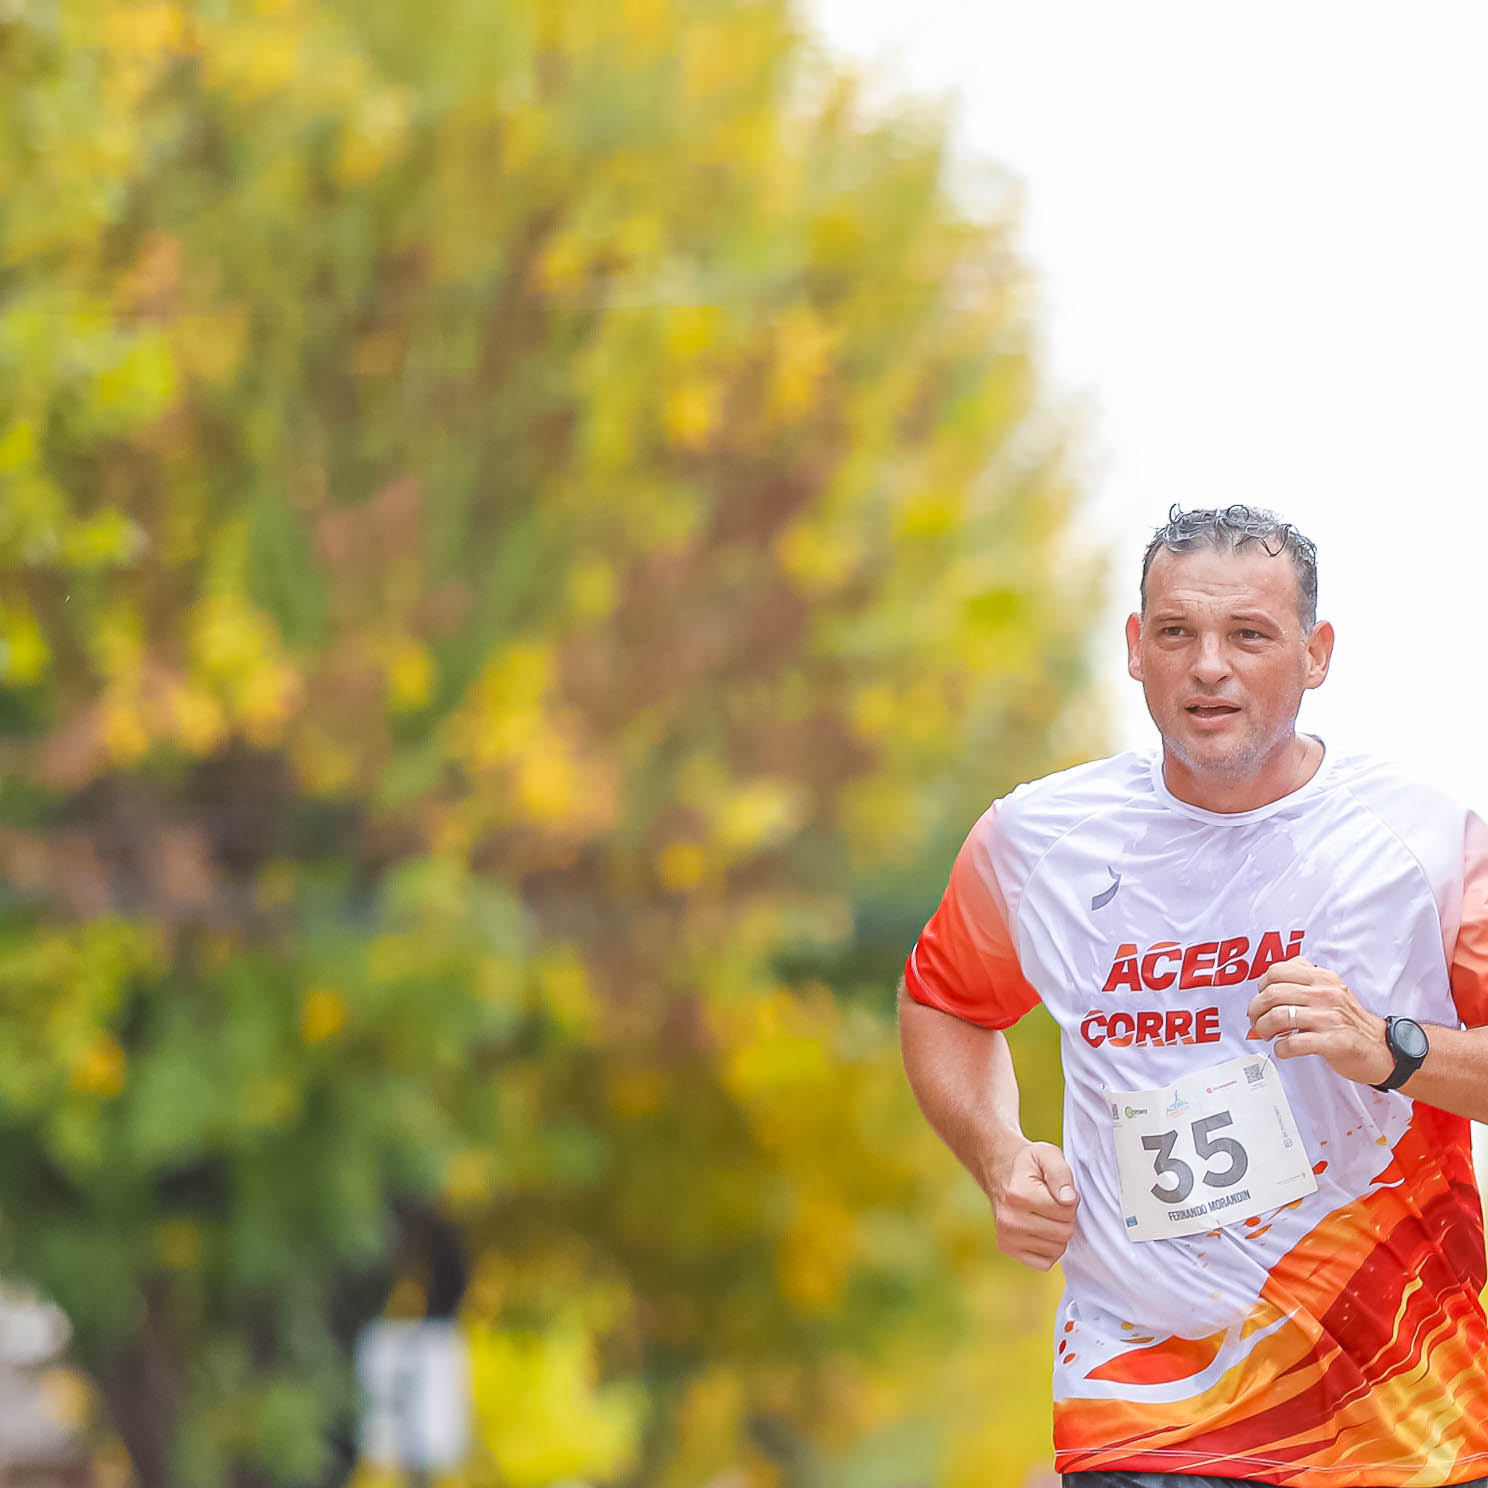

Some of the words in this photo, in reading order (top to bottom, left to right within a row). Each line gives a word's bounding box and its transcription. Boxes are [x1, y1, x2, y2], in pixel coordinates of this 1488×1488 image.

[1080, 1007, 1221, 1048] CORRE
[1141, 1111, 1248, 1203] 35
[1168, 1204, 1208, 1221] FERNANDO
[1209, 1189, 1252, 1212] MORANDIN
